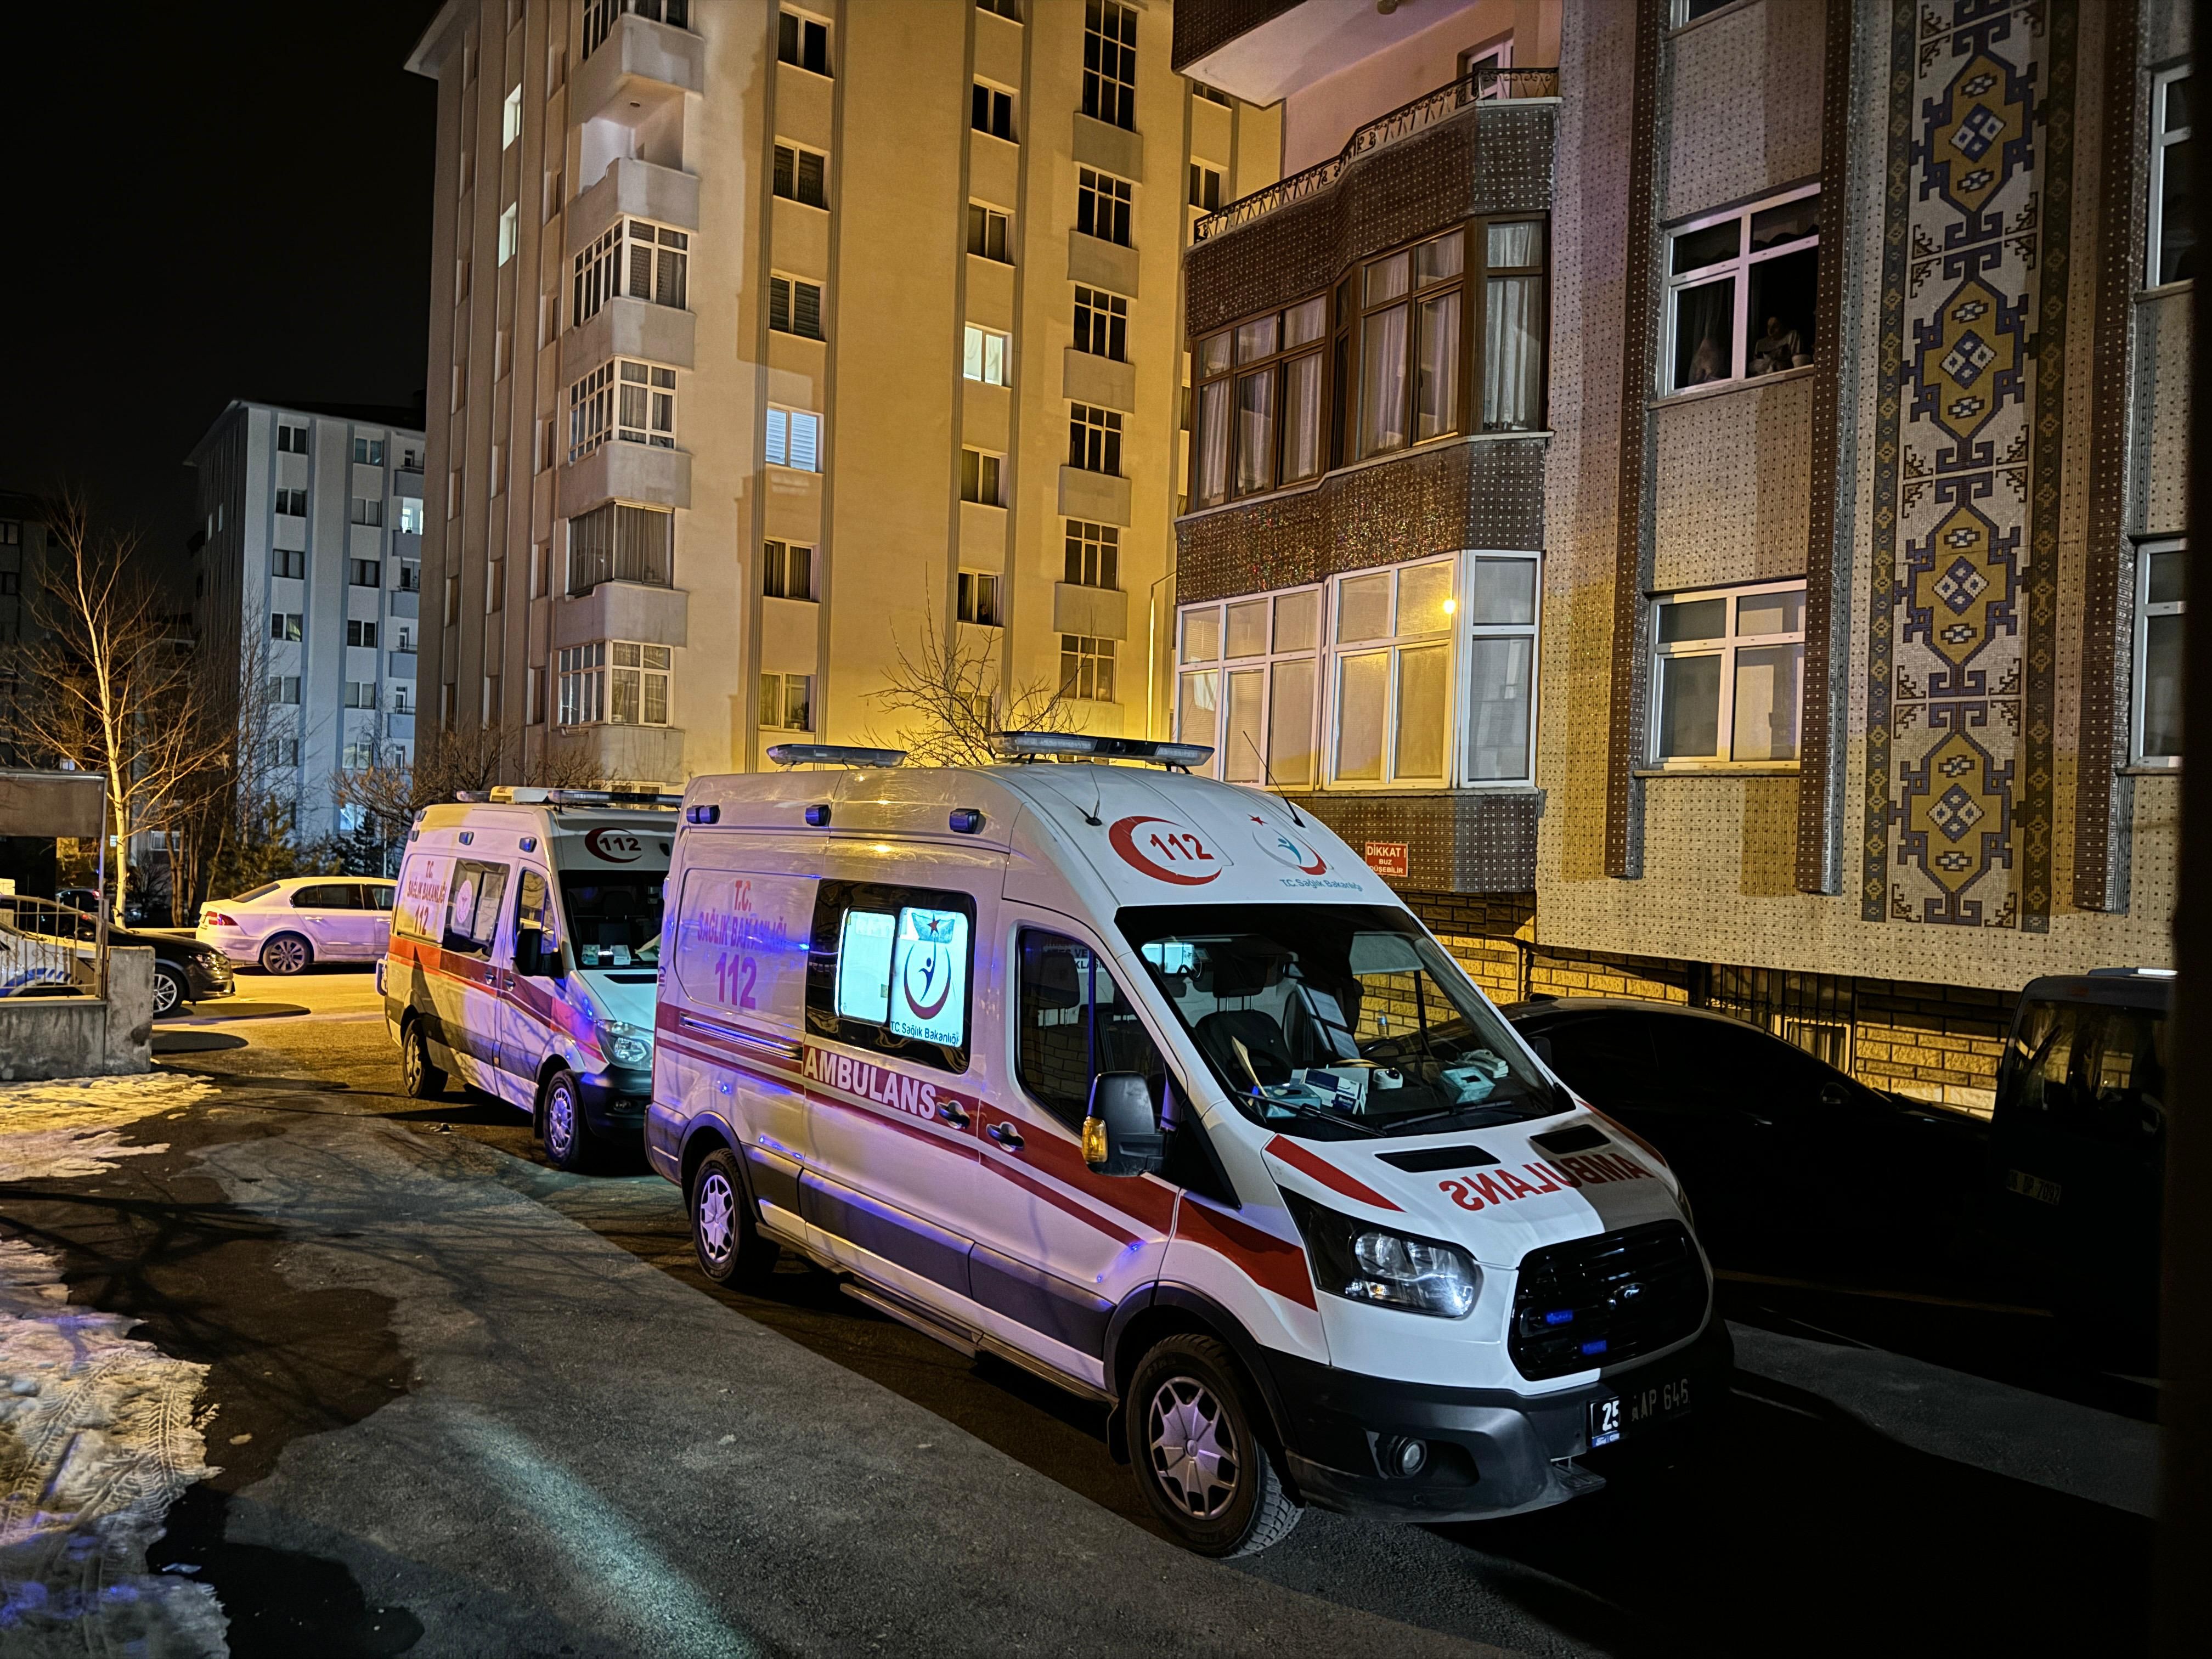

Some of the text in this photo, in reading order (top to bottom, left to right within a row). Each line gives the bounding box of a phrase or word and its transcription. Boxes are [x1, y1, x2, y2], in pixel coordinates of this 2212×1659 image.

[600, 837, 641, 851] 112
[1150, 833, 1215, 860] 112
[1367, 844, 1401, 857] DİKKAT
[407, 877, 447, 904] SAĞLIK BAKANLIĞI
[734, 880, 752, 912] T.C.
[1295, 879, 1324, 889] Sağlık
[1323, 880, 1363, 892] Bakanlığı
[414, 905, 429, 935] 112
[697, 908, 730, 946] SAĞLIK
[715, 952, 757, 1010] 112
[890, 1021, 959, 1047] T.C. Sağlık Bakanlığı
[804, 1047, 936, 1120] AMBULANS
[1602, 1400, 1621, 1431] 25
[1663, 1379, 1689, 1410] 646
